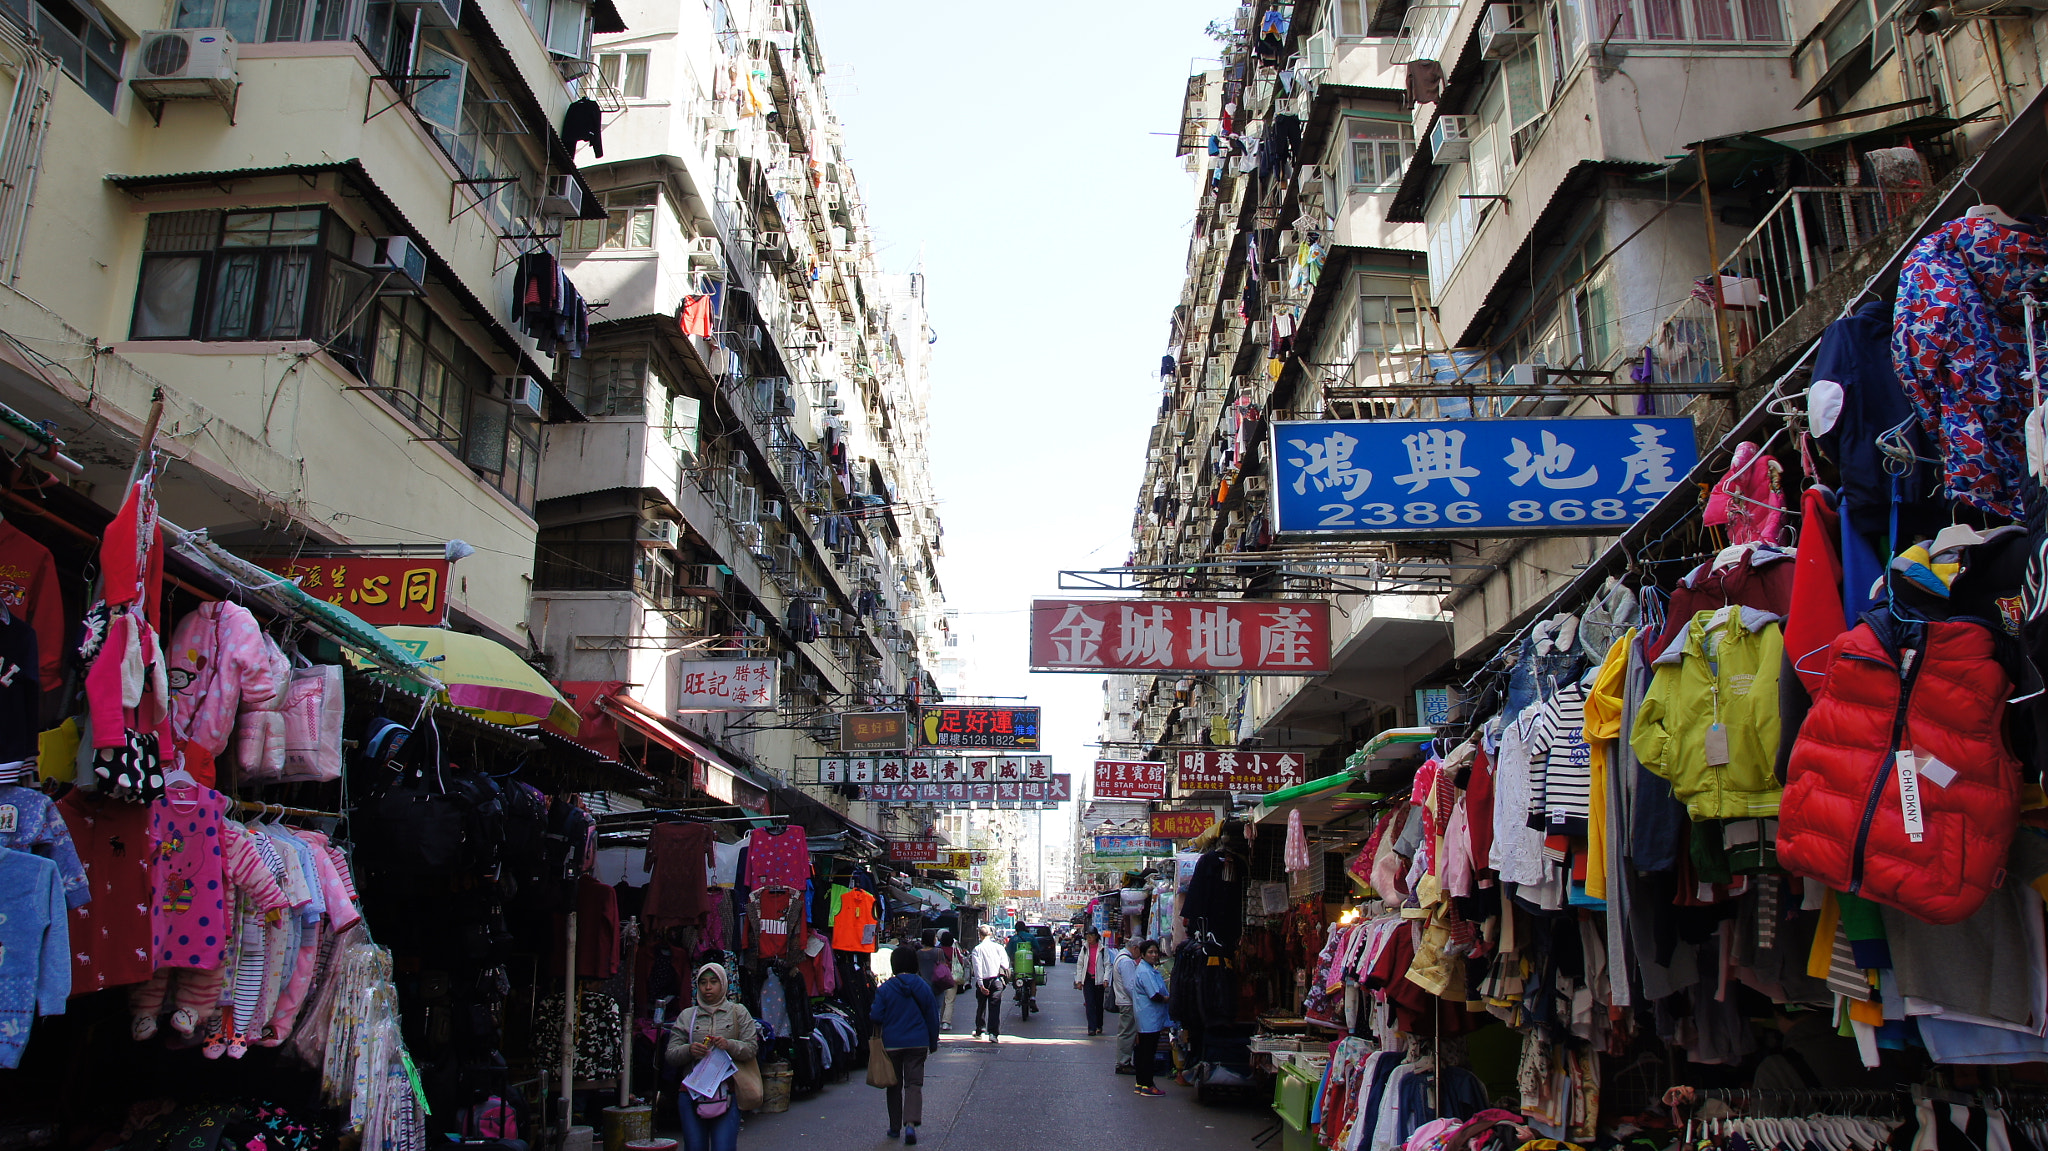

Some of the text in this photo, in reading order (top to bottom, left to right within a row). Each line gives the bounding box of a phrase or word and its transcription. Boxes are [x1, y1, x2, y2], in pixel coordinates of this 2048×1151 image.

[1287, 424, 1683, 501] 鴻興地產
[1318, 501, 1483, 526] 2386
[351, 568, 438, 613] 同心
[1048, 603, 1314, 667] 金城地產
[683, 670, 730, 698] 旺記
[732, 684, 770, 704] 海味
[939, 710, 1013, 734] 足好運
[1014, 712, 1037, 723] 穴位
[938, 733, 1015, 746] 閣樓 5126 1822
[1096, 764, 1164, 782] 利星賓館
[1184, 752, 1299, 776] 明發小食
[1902, 769, 1918, 823] CHN DKNY
